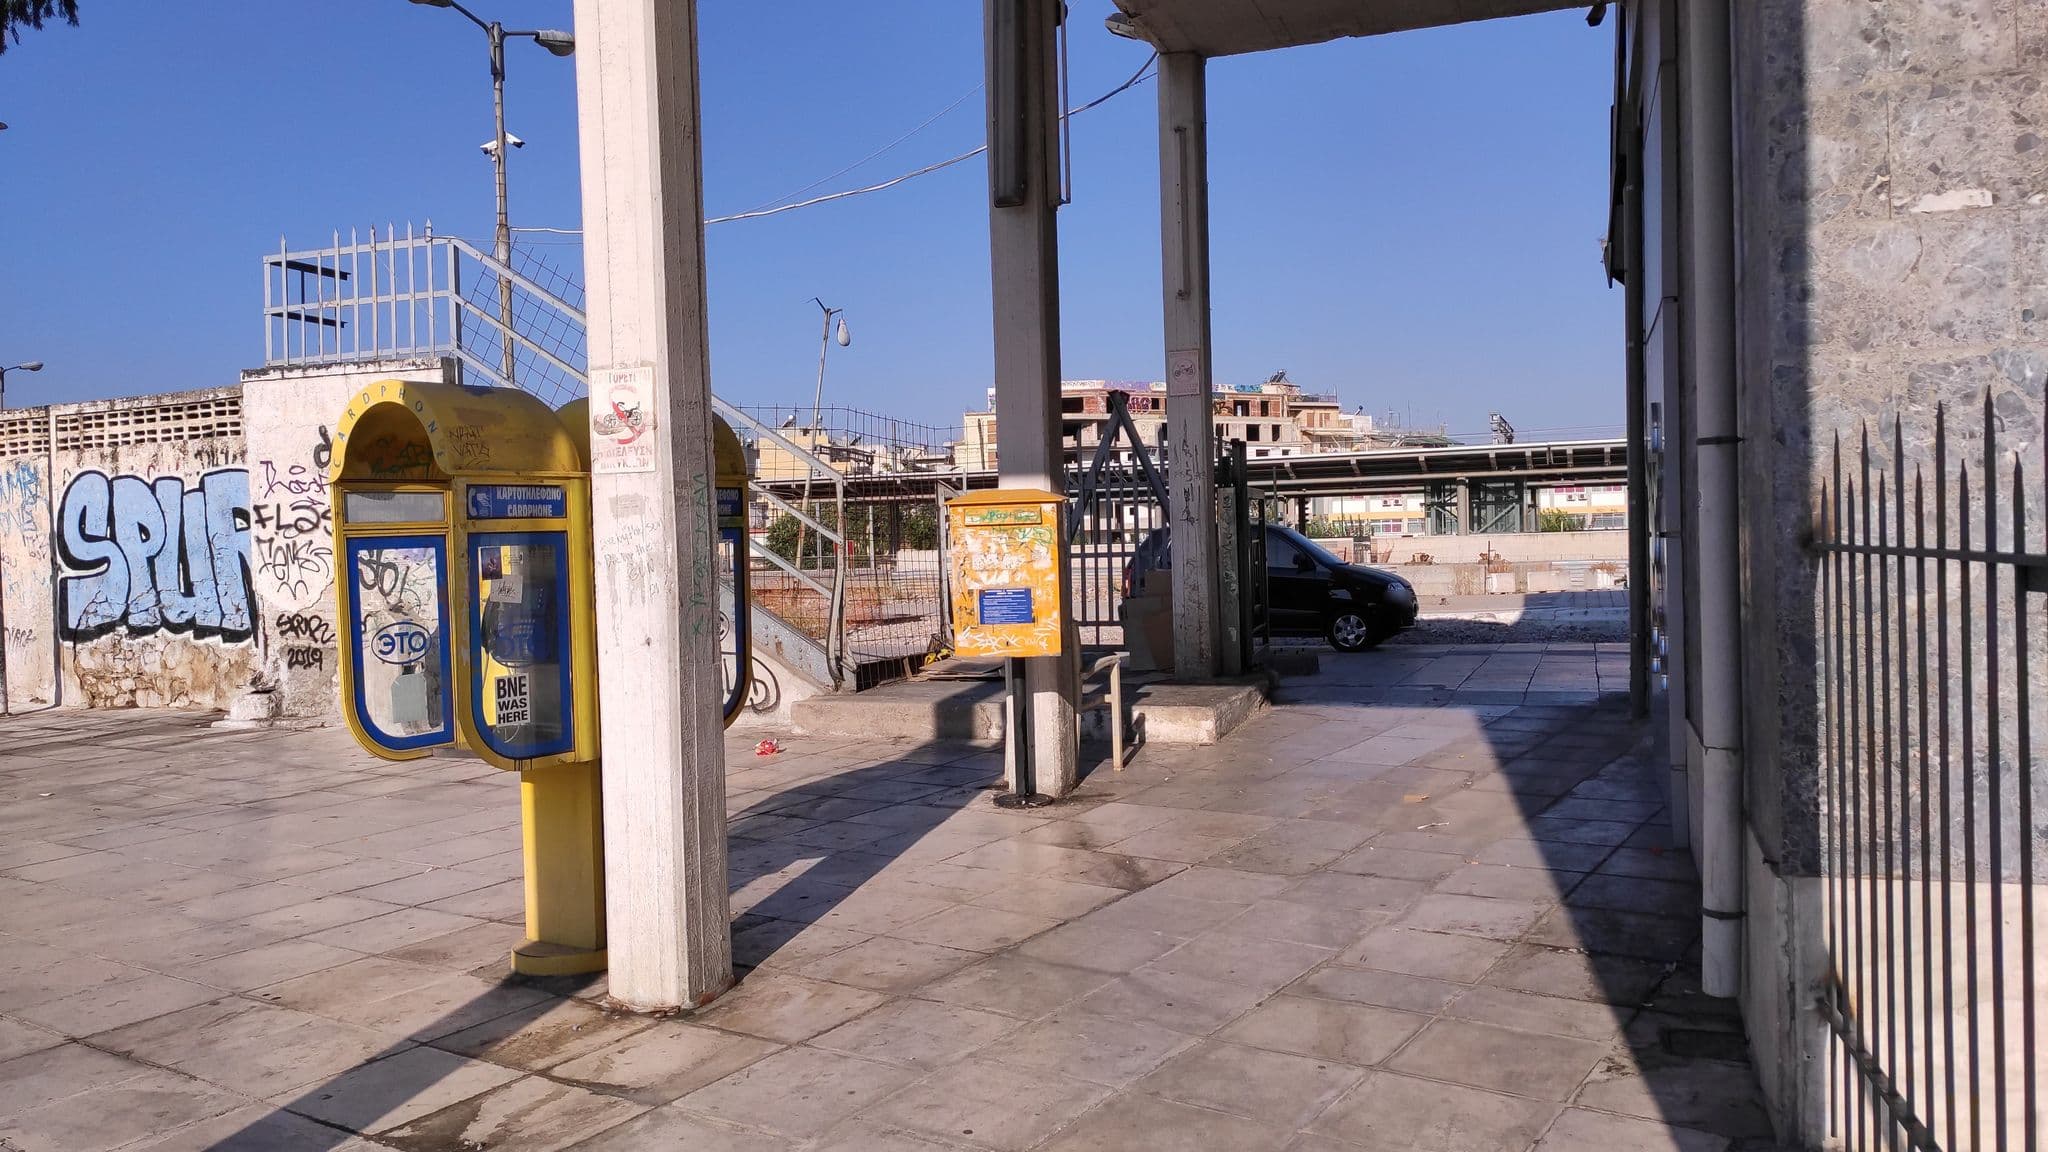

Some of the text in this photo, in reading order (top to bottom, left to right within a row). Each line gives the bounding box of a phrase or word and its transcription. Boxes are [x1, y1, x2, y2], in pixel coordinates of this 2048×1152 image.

[333, 384, 444, 468] CARDPHONE
[496, 486, 562, 500] ΚΑΡΤΟΤΗΛΕΦΩΝΟ
[507, 504, 553, 517] CARDPHONE
[57, 469, 254, 643] SPUR
[287, 648, 323, 672] 2019
[496, 675, 527, 699] BNE
[497, 697, 528, 712] WAS
[497, 709, 528, 725] HERE
